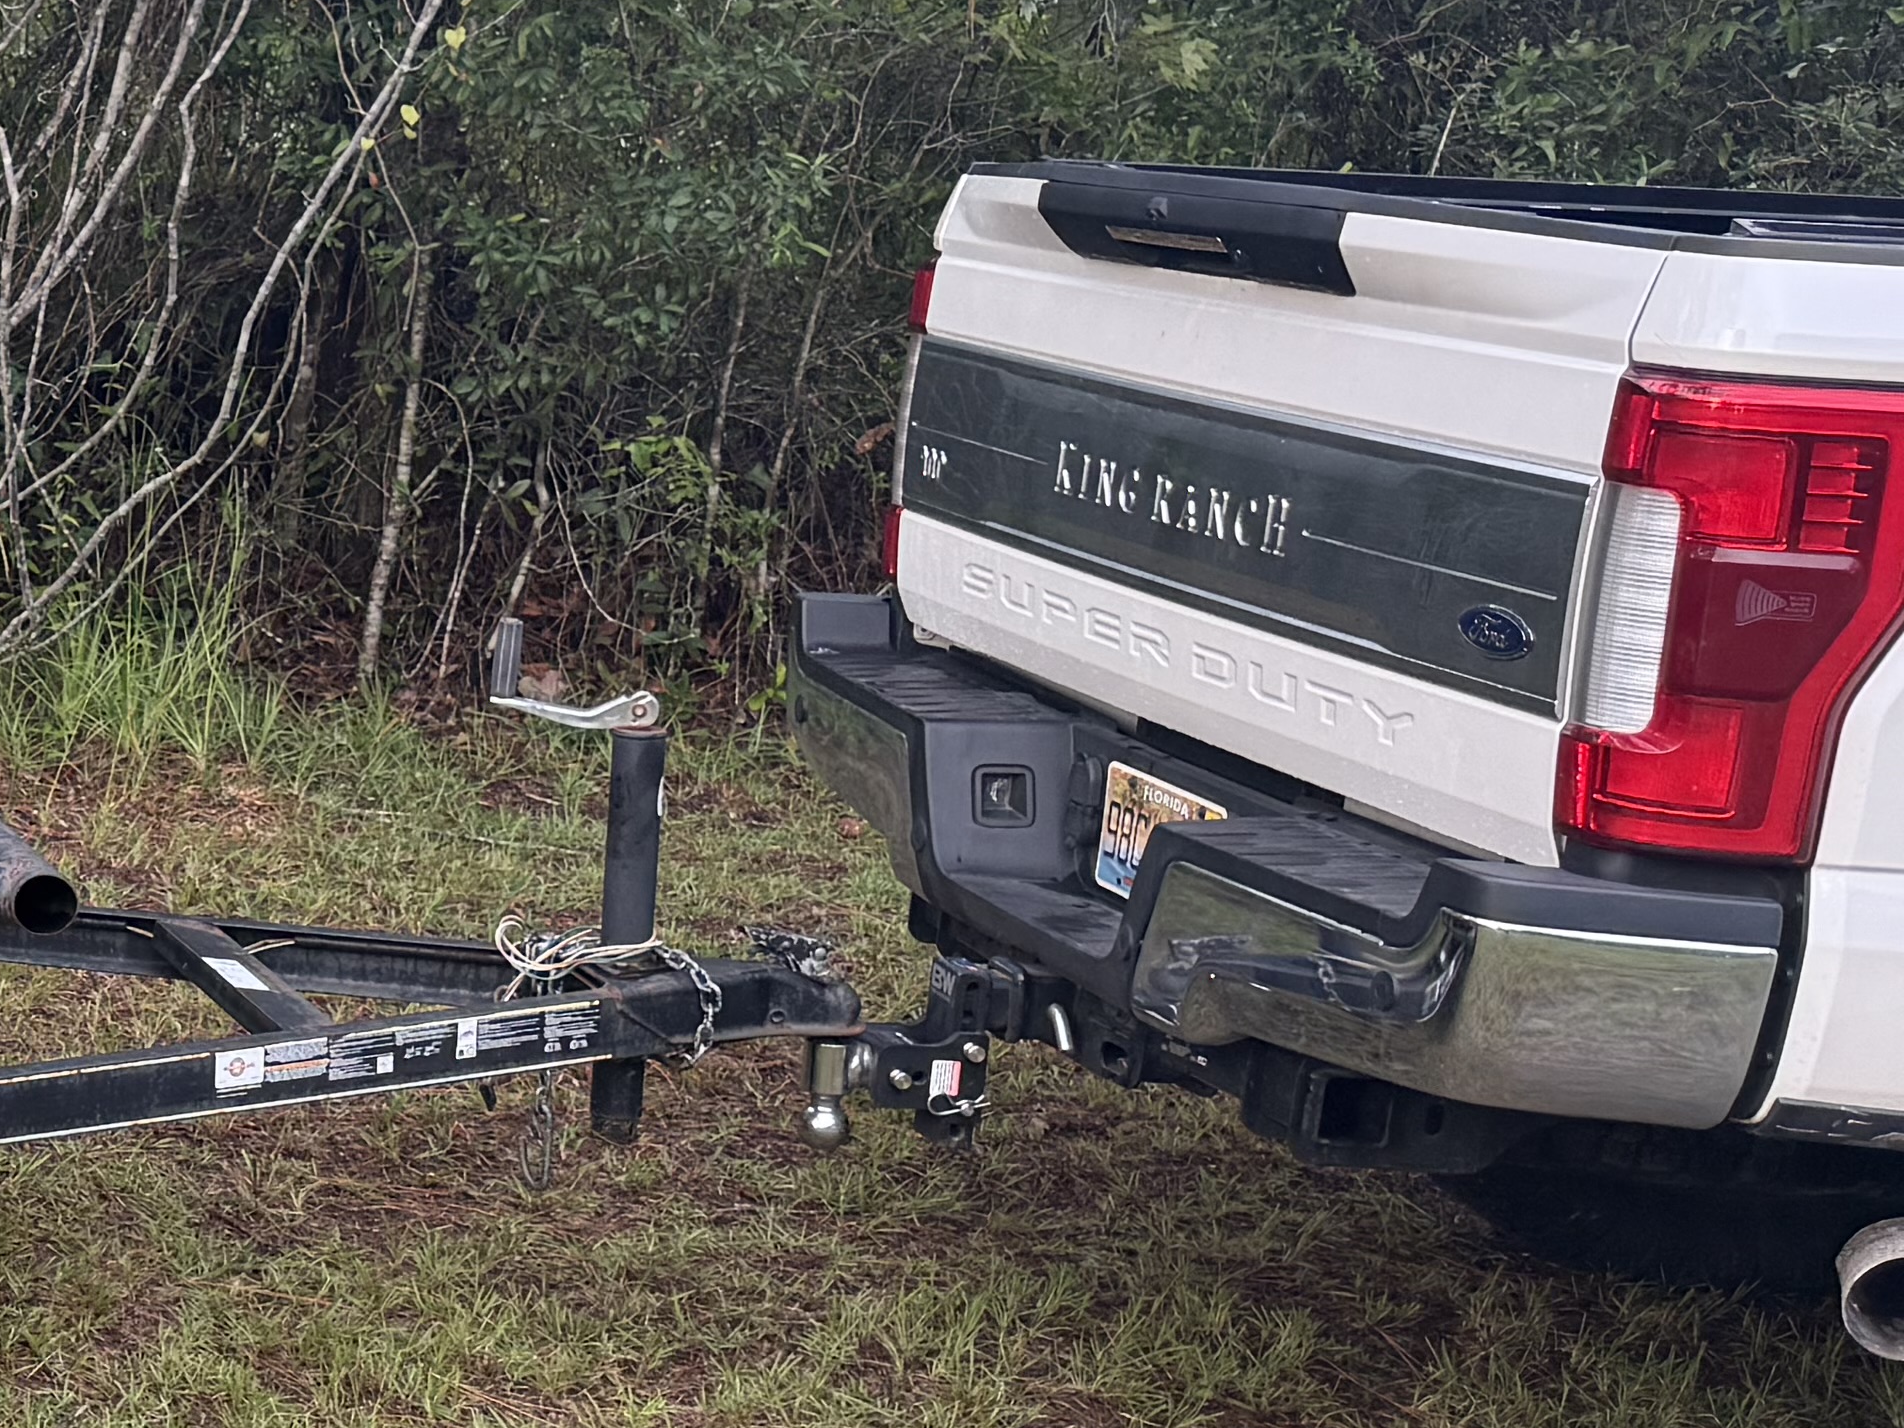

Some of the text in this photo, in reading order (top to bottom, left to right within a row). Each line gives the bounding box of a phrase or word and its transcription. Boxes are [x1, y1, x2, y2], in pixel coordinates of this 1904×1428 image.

[1054, 441, 1293, 557] KING RANCH
[962, 563, 1414, 747] SUPER DUTY
[1143, 784, 1190, 820] FLORIDA
